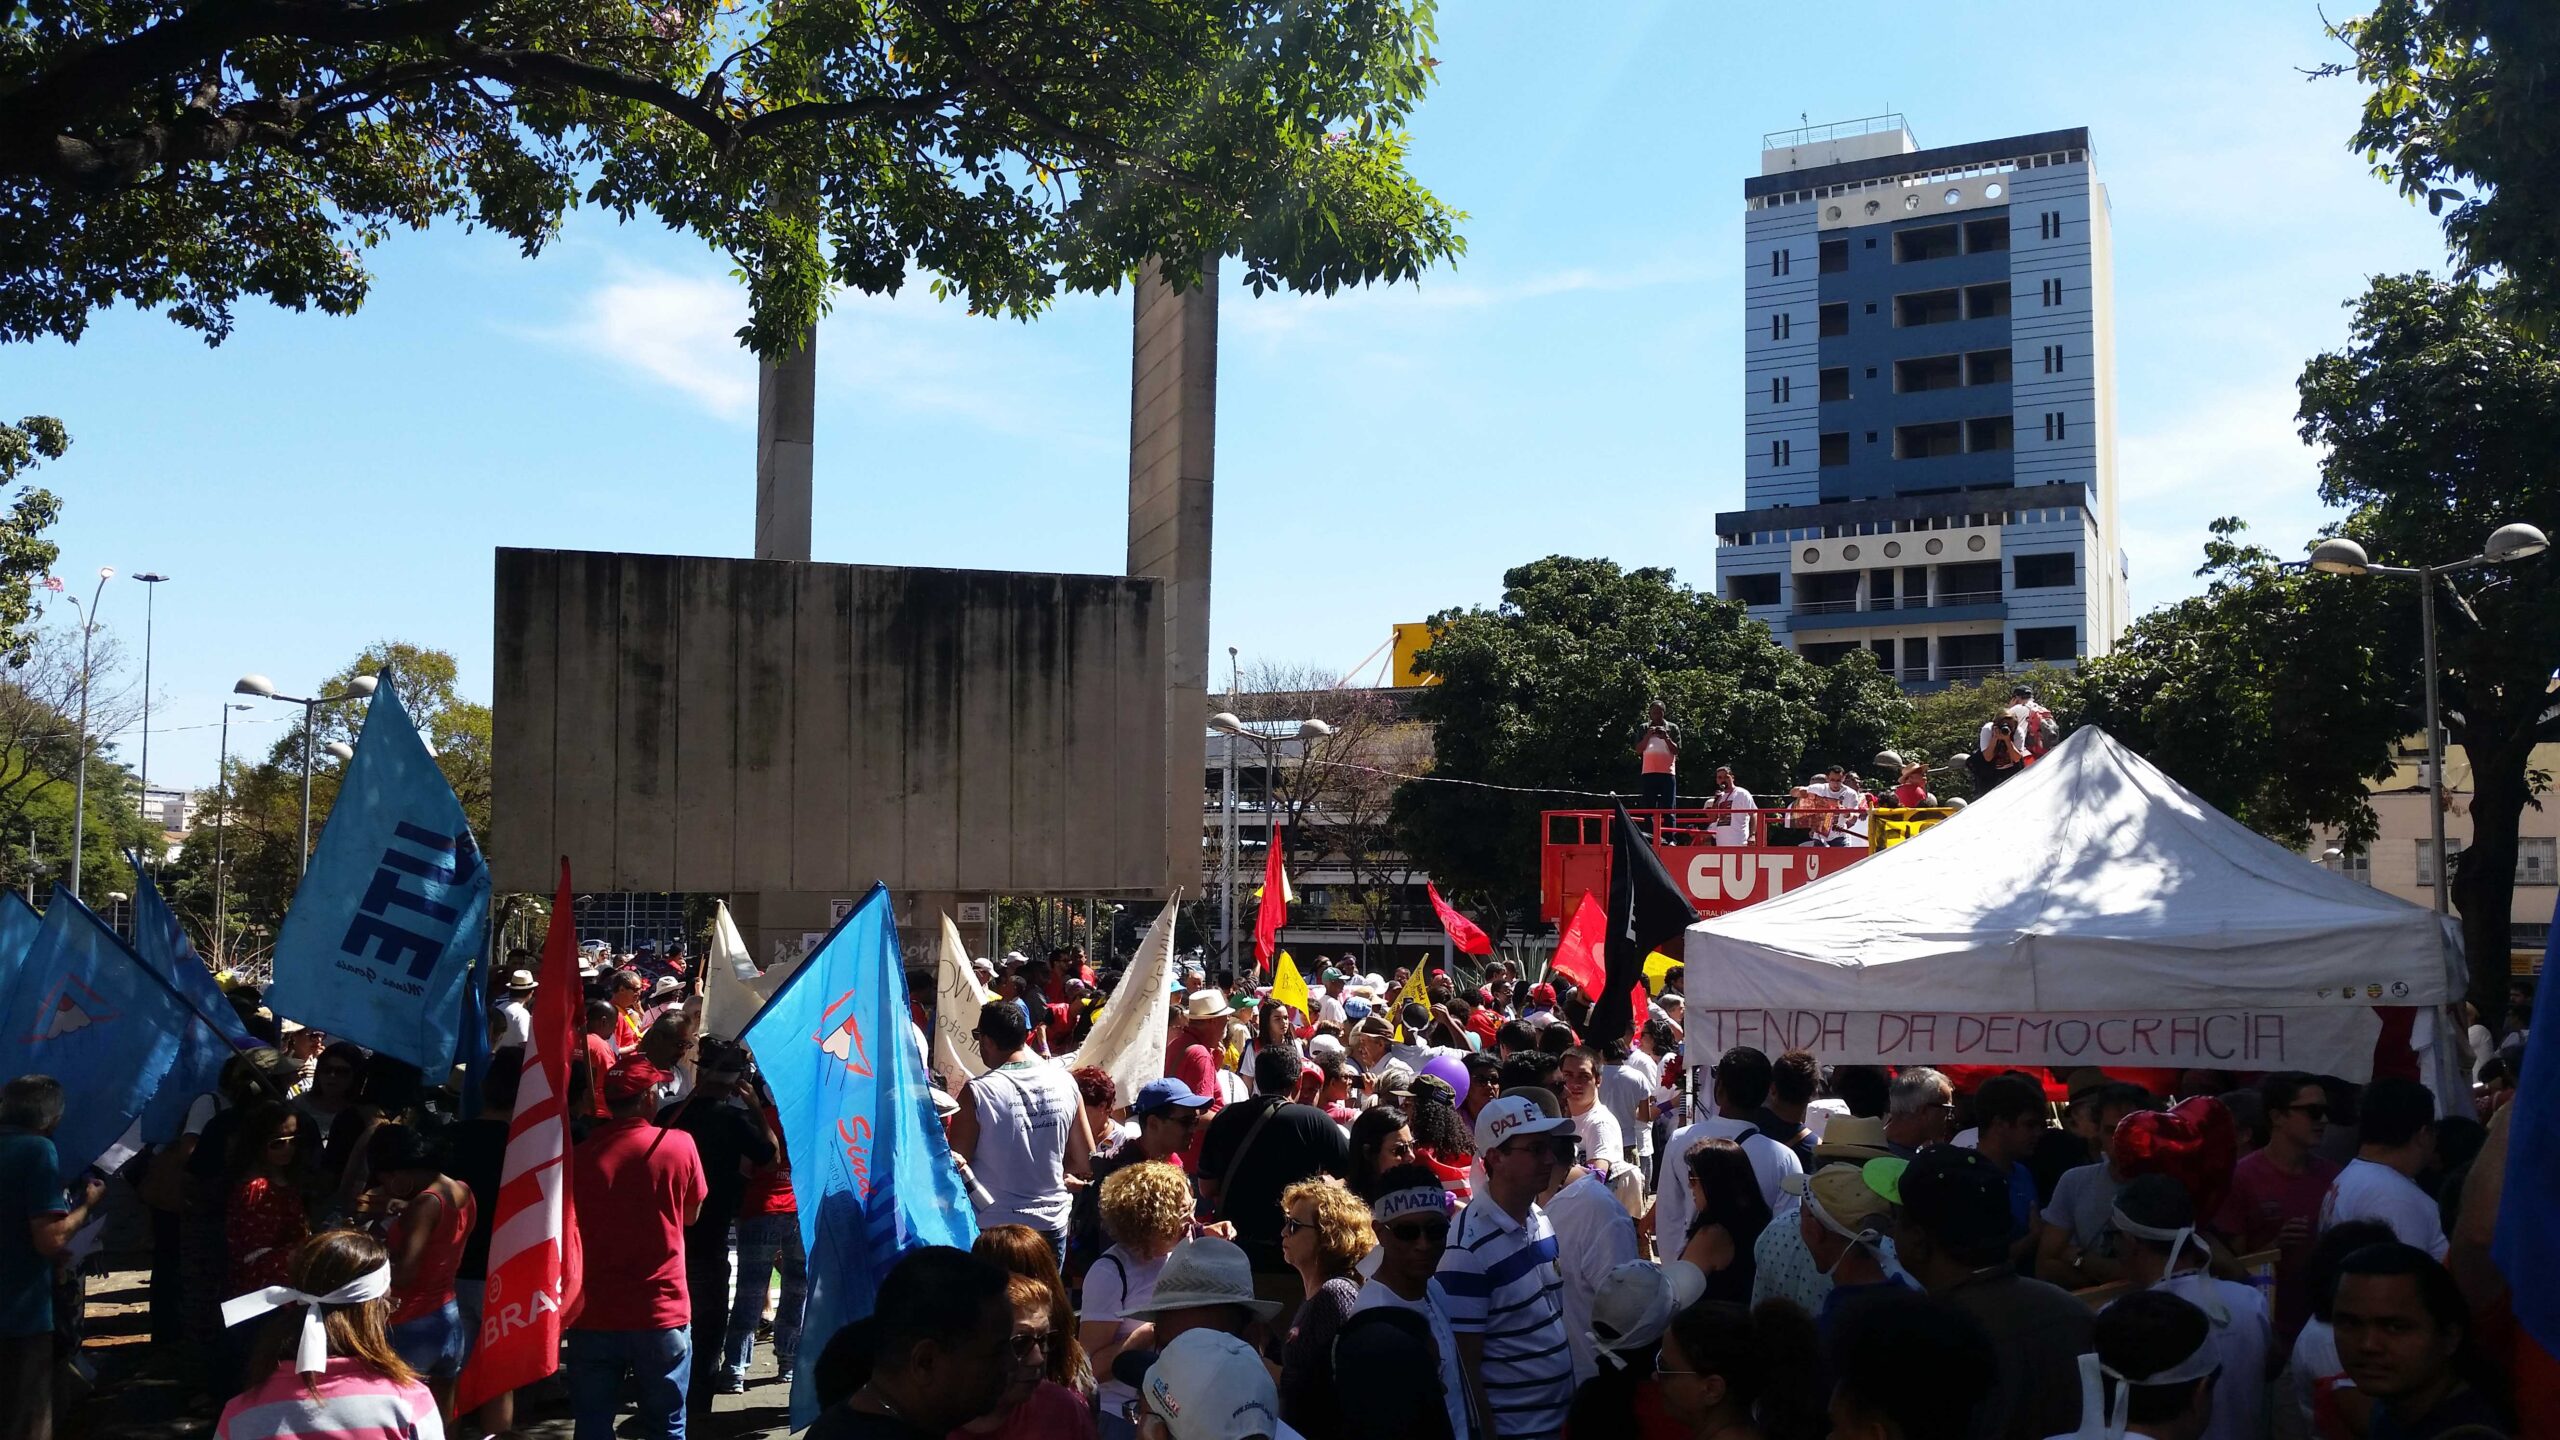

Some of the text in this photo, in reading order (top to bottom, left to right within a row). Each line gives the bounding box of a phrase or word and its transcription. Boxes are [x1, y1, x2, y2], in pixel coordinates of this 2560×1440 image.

[1687, 854, 1793, 900] CUT
[1705, 1008, 1848, 1053] TENDA
[1877, 1013, 1936, 1055] DA
[1491, 1112, 1522, 1138] PAZ
